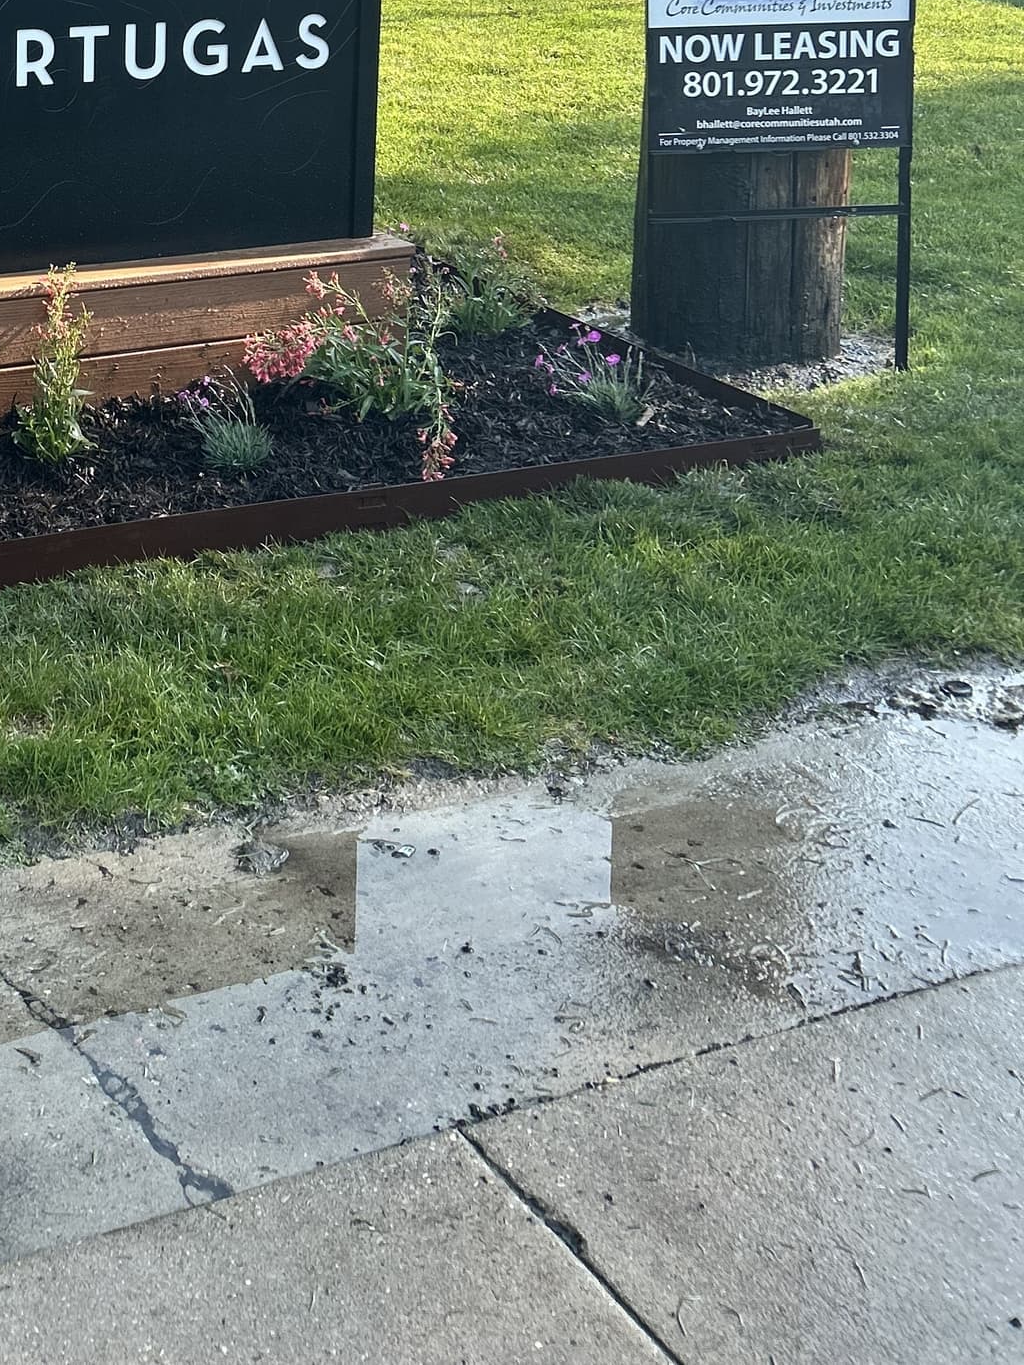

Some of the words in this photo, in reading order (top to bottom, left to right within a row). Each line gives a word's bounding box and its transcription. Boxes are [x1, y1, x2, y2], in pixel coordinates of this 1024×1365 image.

[659, 33, 745, 64] NOW
[754, 29, 900, 61] LEASING
[682, 68, 878, 98] 801.972.3221
[746, 106, 779, 118] BayLee
[780, 105, 813, 116] Hallett
[696, 117, 862, 130] bhallett@corecommunitiesutah.com
[659, 138, 672, 147] For
[673, 136, 707, 148] Property
[707, 135, 759, 146] Management
[760, 134, 805, 144] Information
[806, 132, 831, 143] Please
[832, 132, 847, 142] Call
